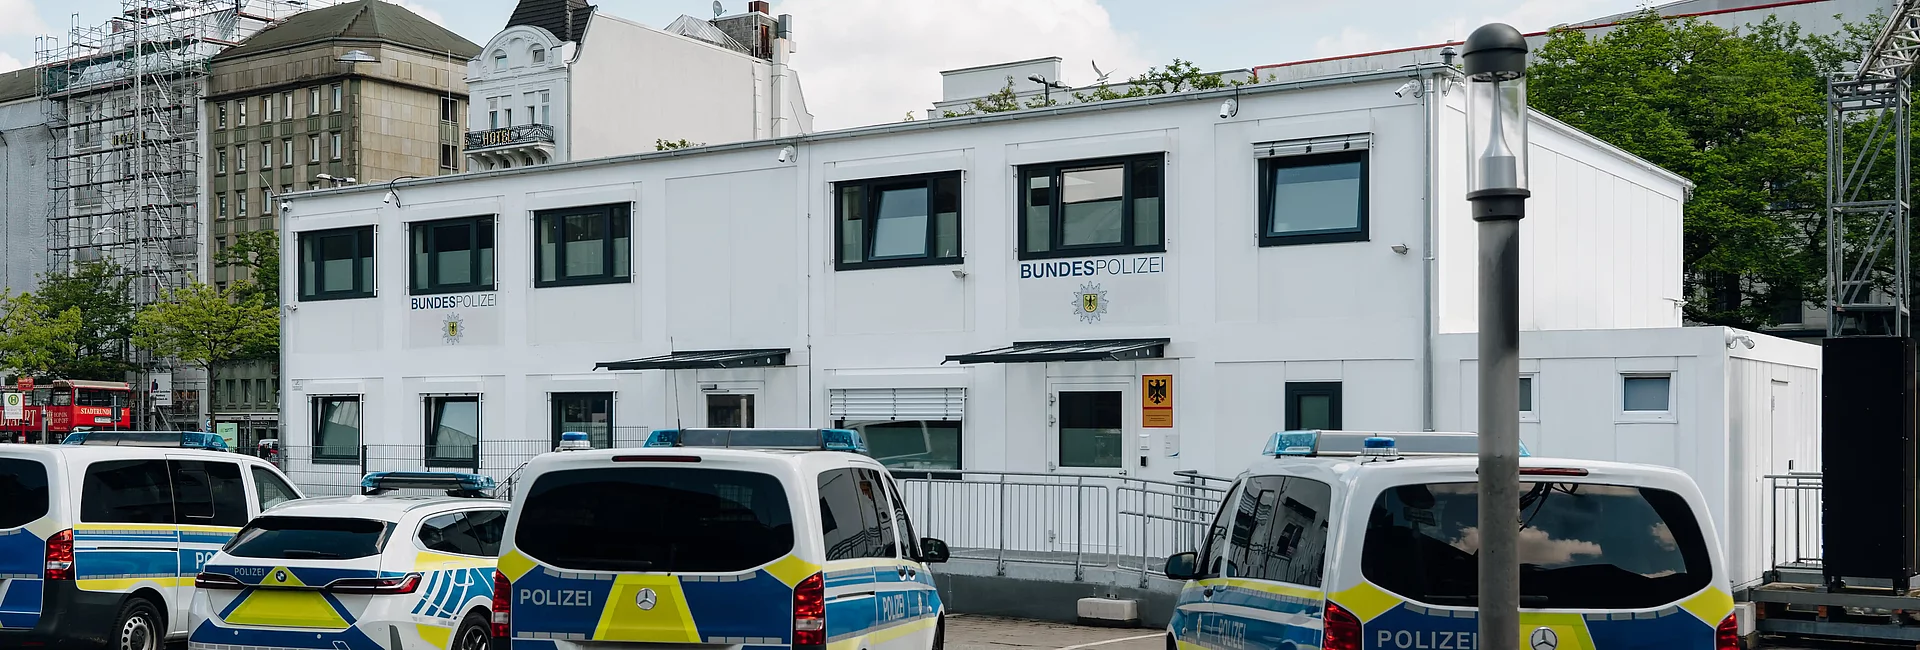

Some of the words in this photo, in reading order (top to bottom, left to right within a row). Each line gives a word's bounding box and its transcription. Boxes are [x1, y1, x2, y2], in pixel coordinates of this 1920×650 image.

[483, 129, 512, 145] HOTEL
[1020, 256, 1164, 279] BUNDESPOLIZEI
[411, 294, 496, 310] BUNDESPOLIZEI
[234, 567, 264, 576] POLIZEI
[519, 588, 592, 607] POLIZEI
[882, 593, 905, 622] POLIZEI
[1216, 616, 1246, 650] POLIZEI
[1377, 630, 1477, 650] POLIZEI
